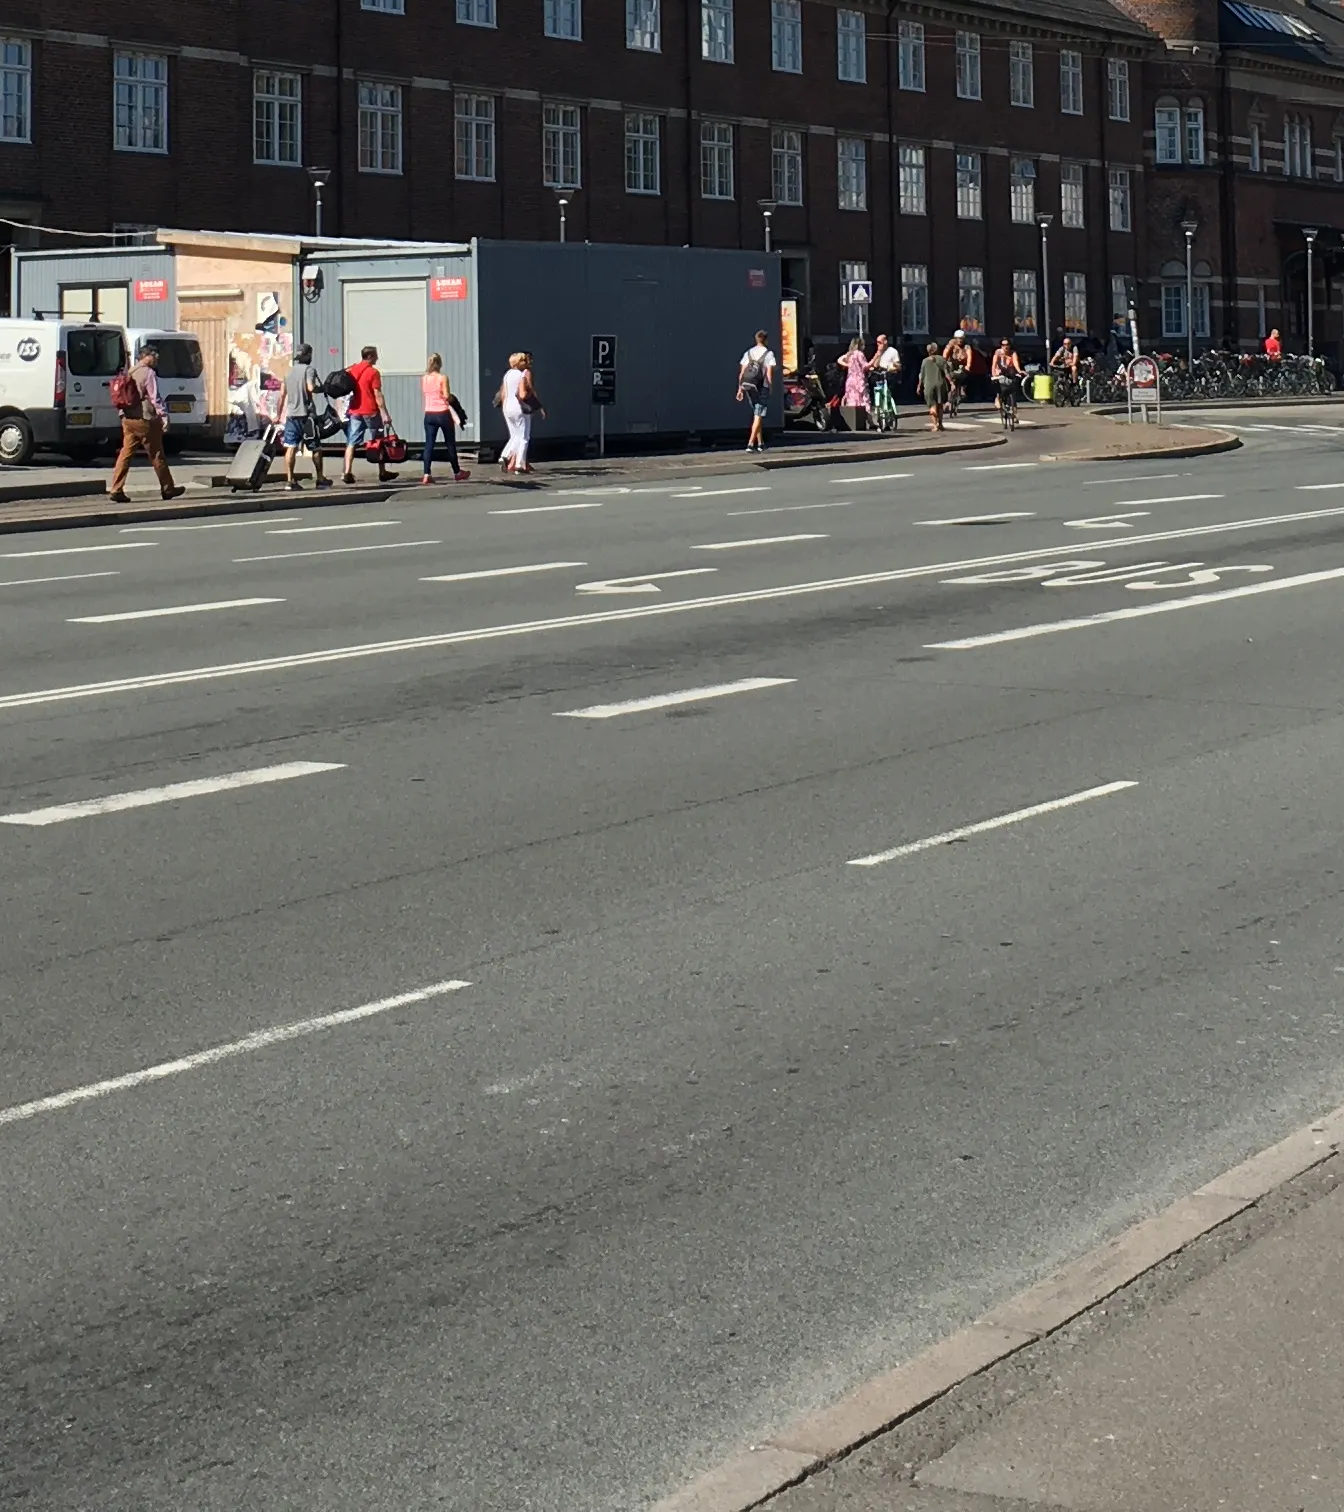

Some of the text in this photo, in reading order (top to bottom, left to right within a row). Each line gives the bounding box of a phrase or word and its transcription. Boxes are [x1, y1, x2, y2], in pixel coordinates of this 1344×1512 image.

[18, 342, 39, 356] ISS
[598, 340, 610, 364] P
[937, 560, 1274, 589] BUS
